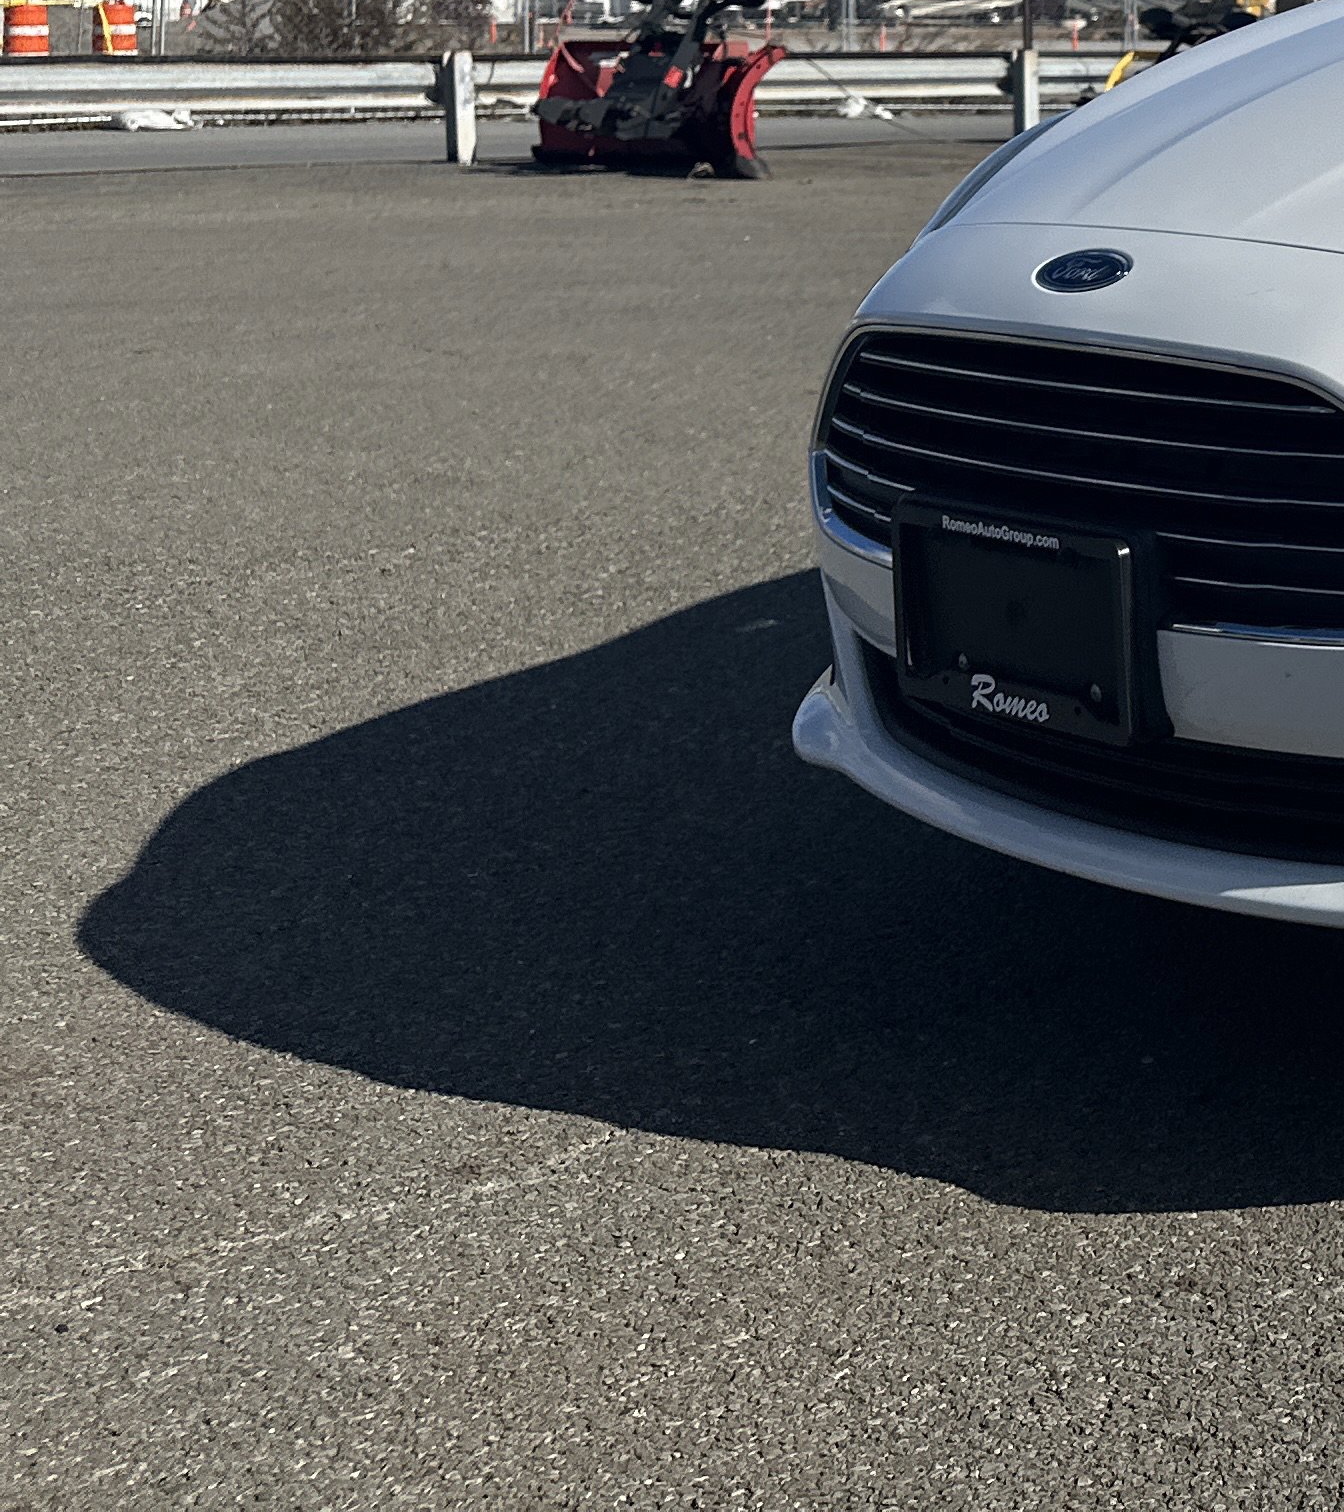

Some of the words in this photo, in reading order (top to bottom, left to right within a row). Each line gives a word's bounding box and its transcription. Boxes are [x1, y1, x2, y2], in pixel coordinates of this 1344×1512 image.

[1051, 256, 1110, 282] Ford
[941, 514, 1060, 549] RomeoAutoGroup.com
[970, 673, 1051, 723] Romeo
